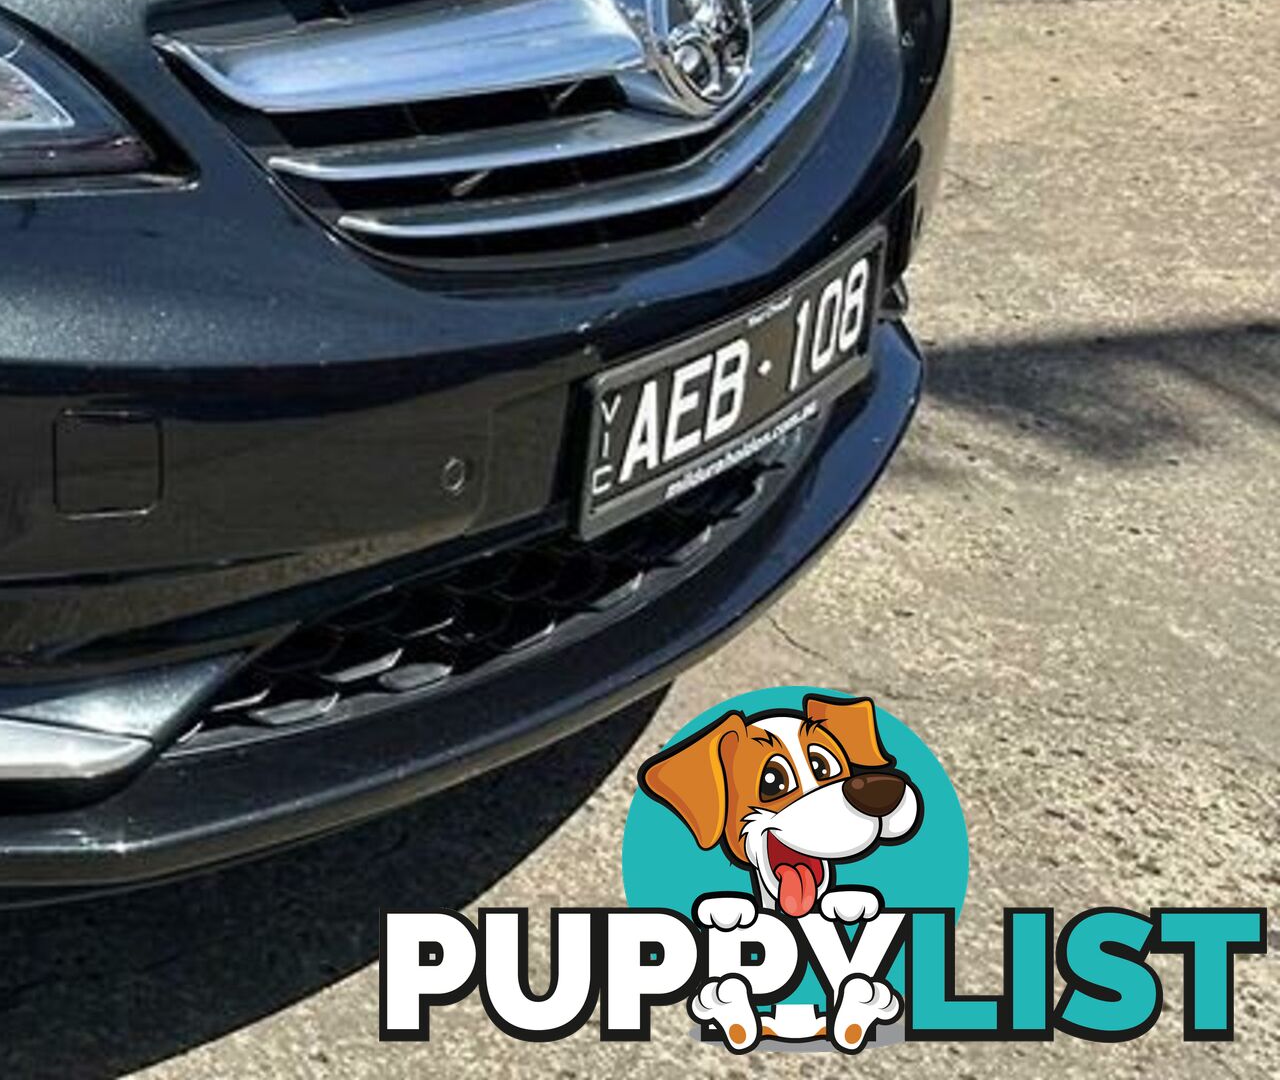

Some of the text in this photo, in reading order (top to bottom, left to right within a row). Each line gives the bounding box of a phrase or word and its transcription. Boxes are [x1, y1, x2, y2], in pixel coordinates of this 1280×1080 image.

[591, 394, 623, 496] VIC
[620, 258, 870, 484] AEB 108
